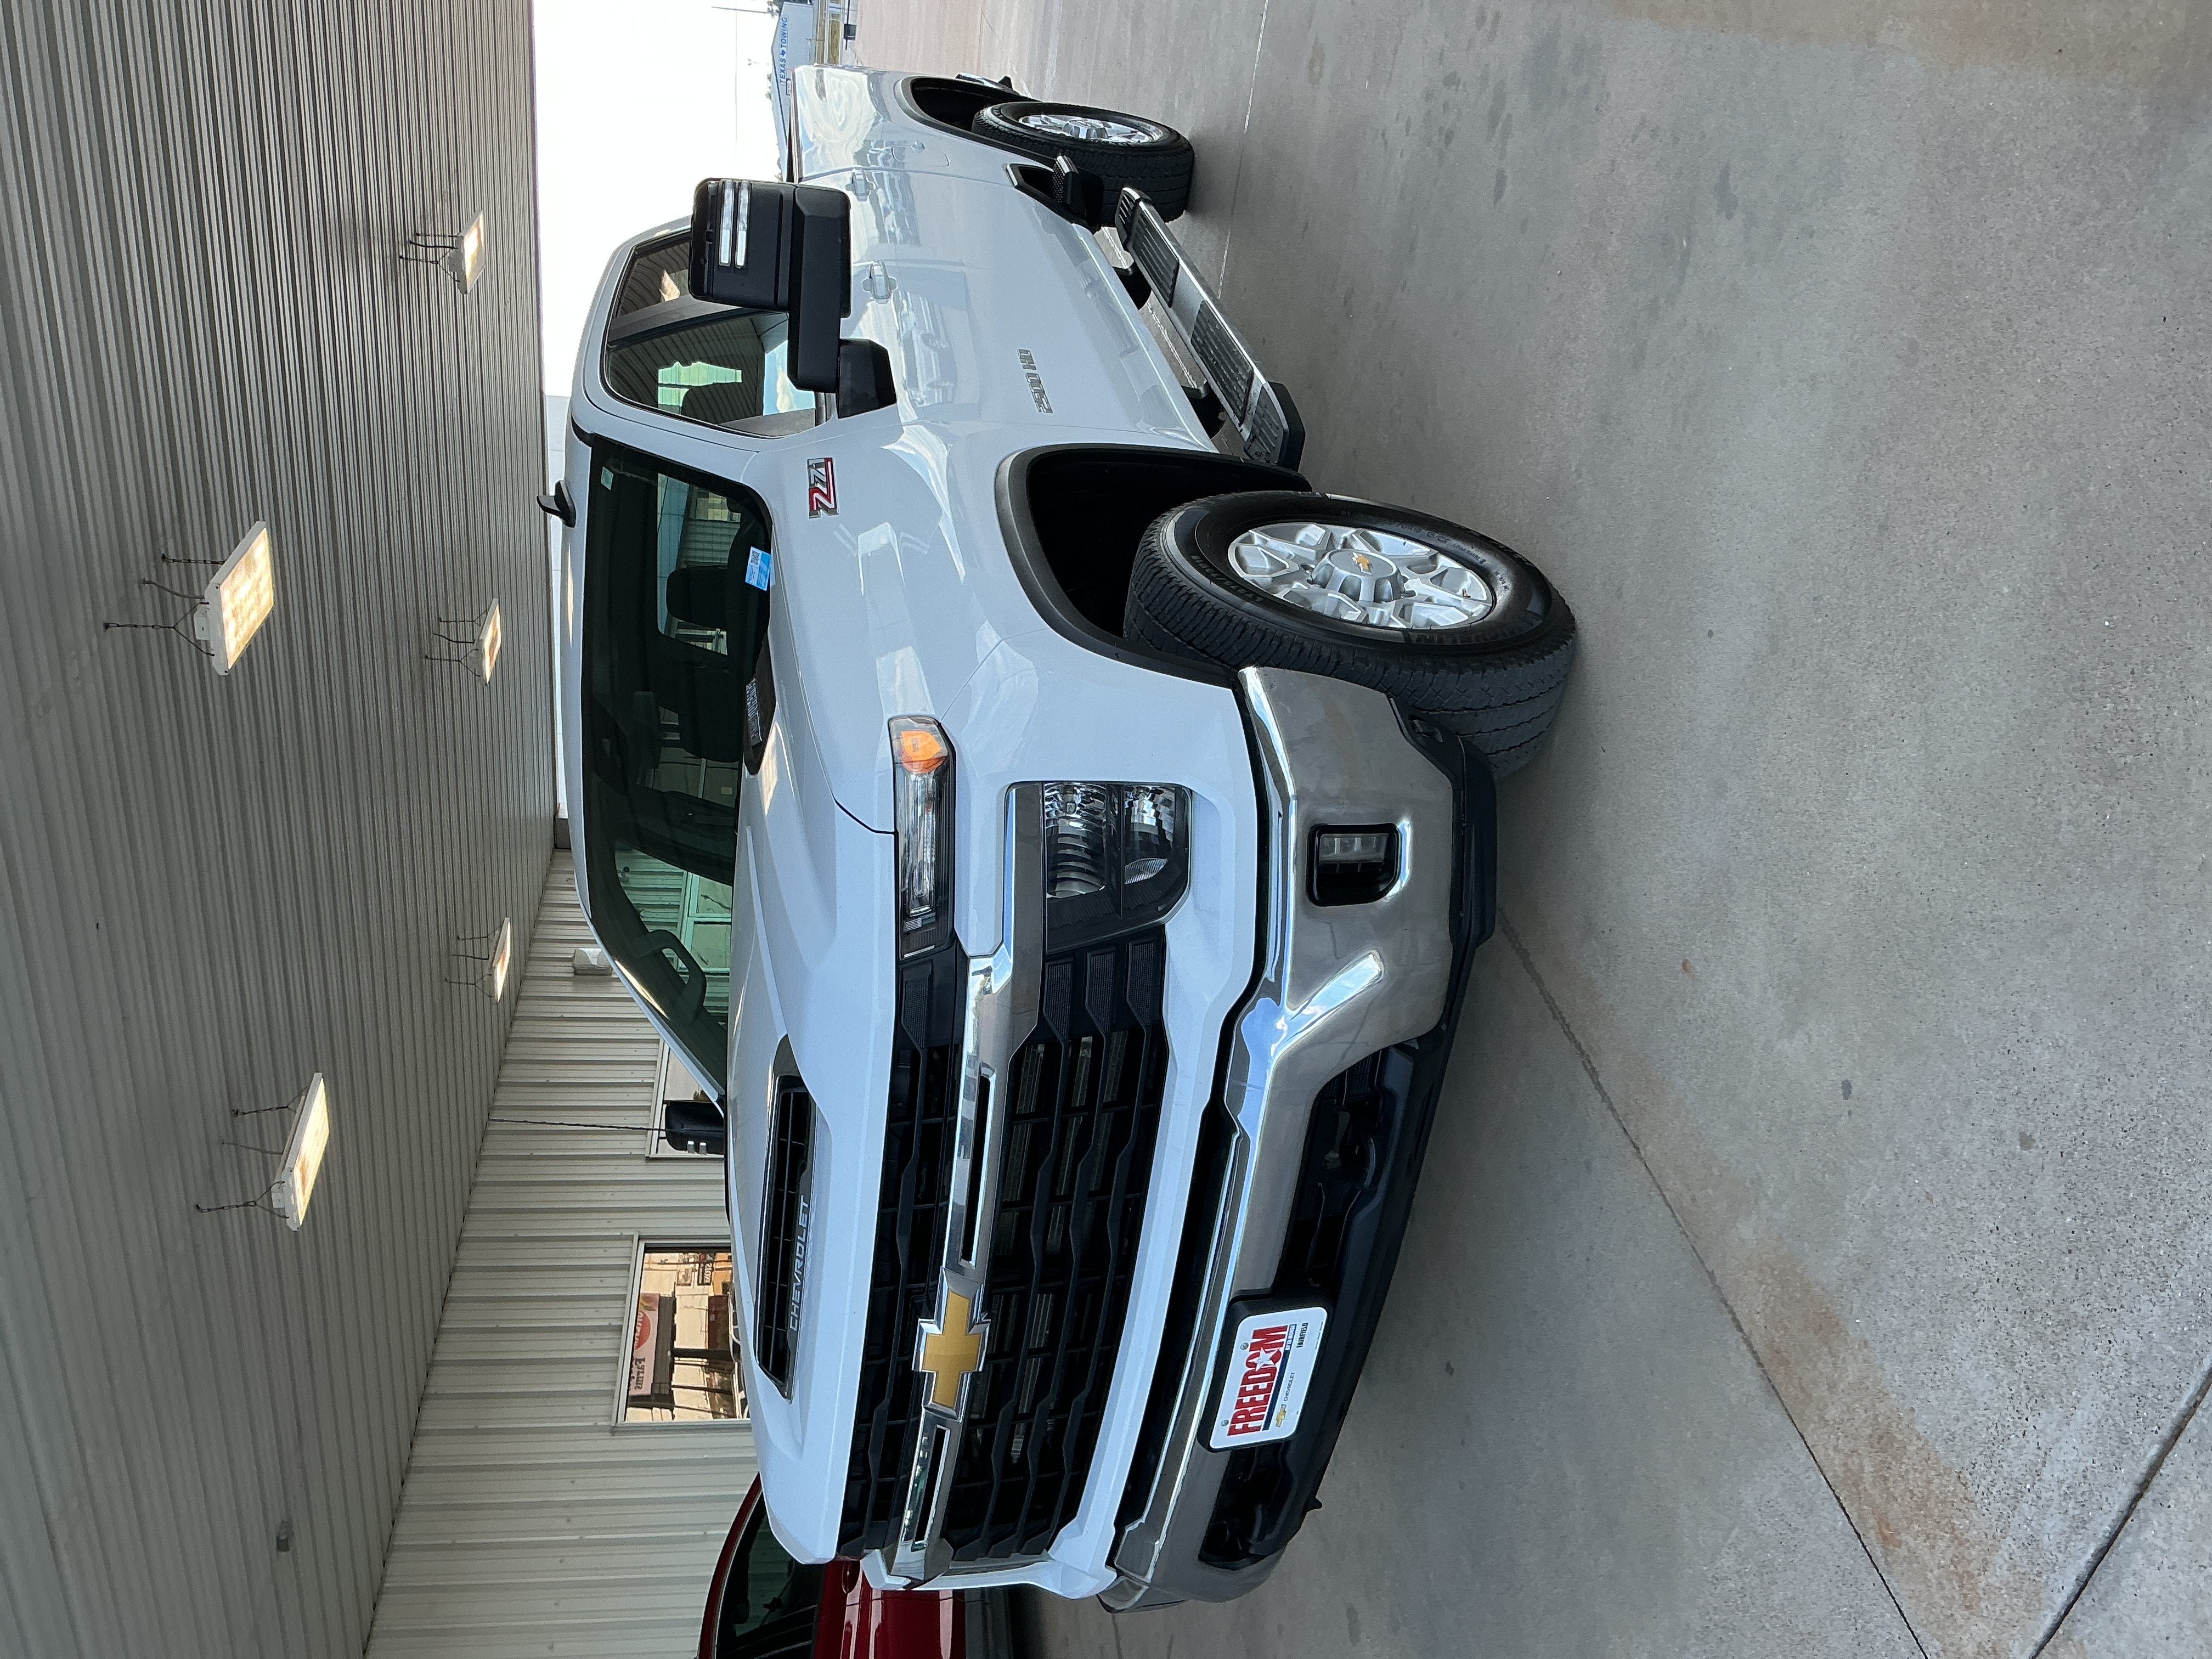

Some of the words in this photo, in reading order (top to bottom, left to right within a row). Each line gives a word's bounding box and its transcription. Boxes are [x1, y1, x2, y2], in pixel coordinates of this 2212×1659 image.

[1017, 348, 1036, 370] HD
[1024, 373, 1053, 414] 2500
[806, 457, 839, 519] Z71
[789, 1194, 809, 1331] CHEVROLET
[1296, 1323, 1308, 1347] FAIRFIELD
[1227, 1325, 1288, 1436] FREEDOM
[1284, 1373, 1295, 1401] CHEVROLET
